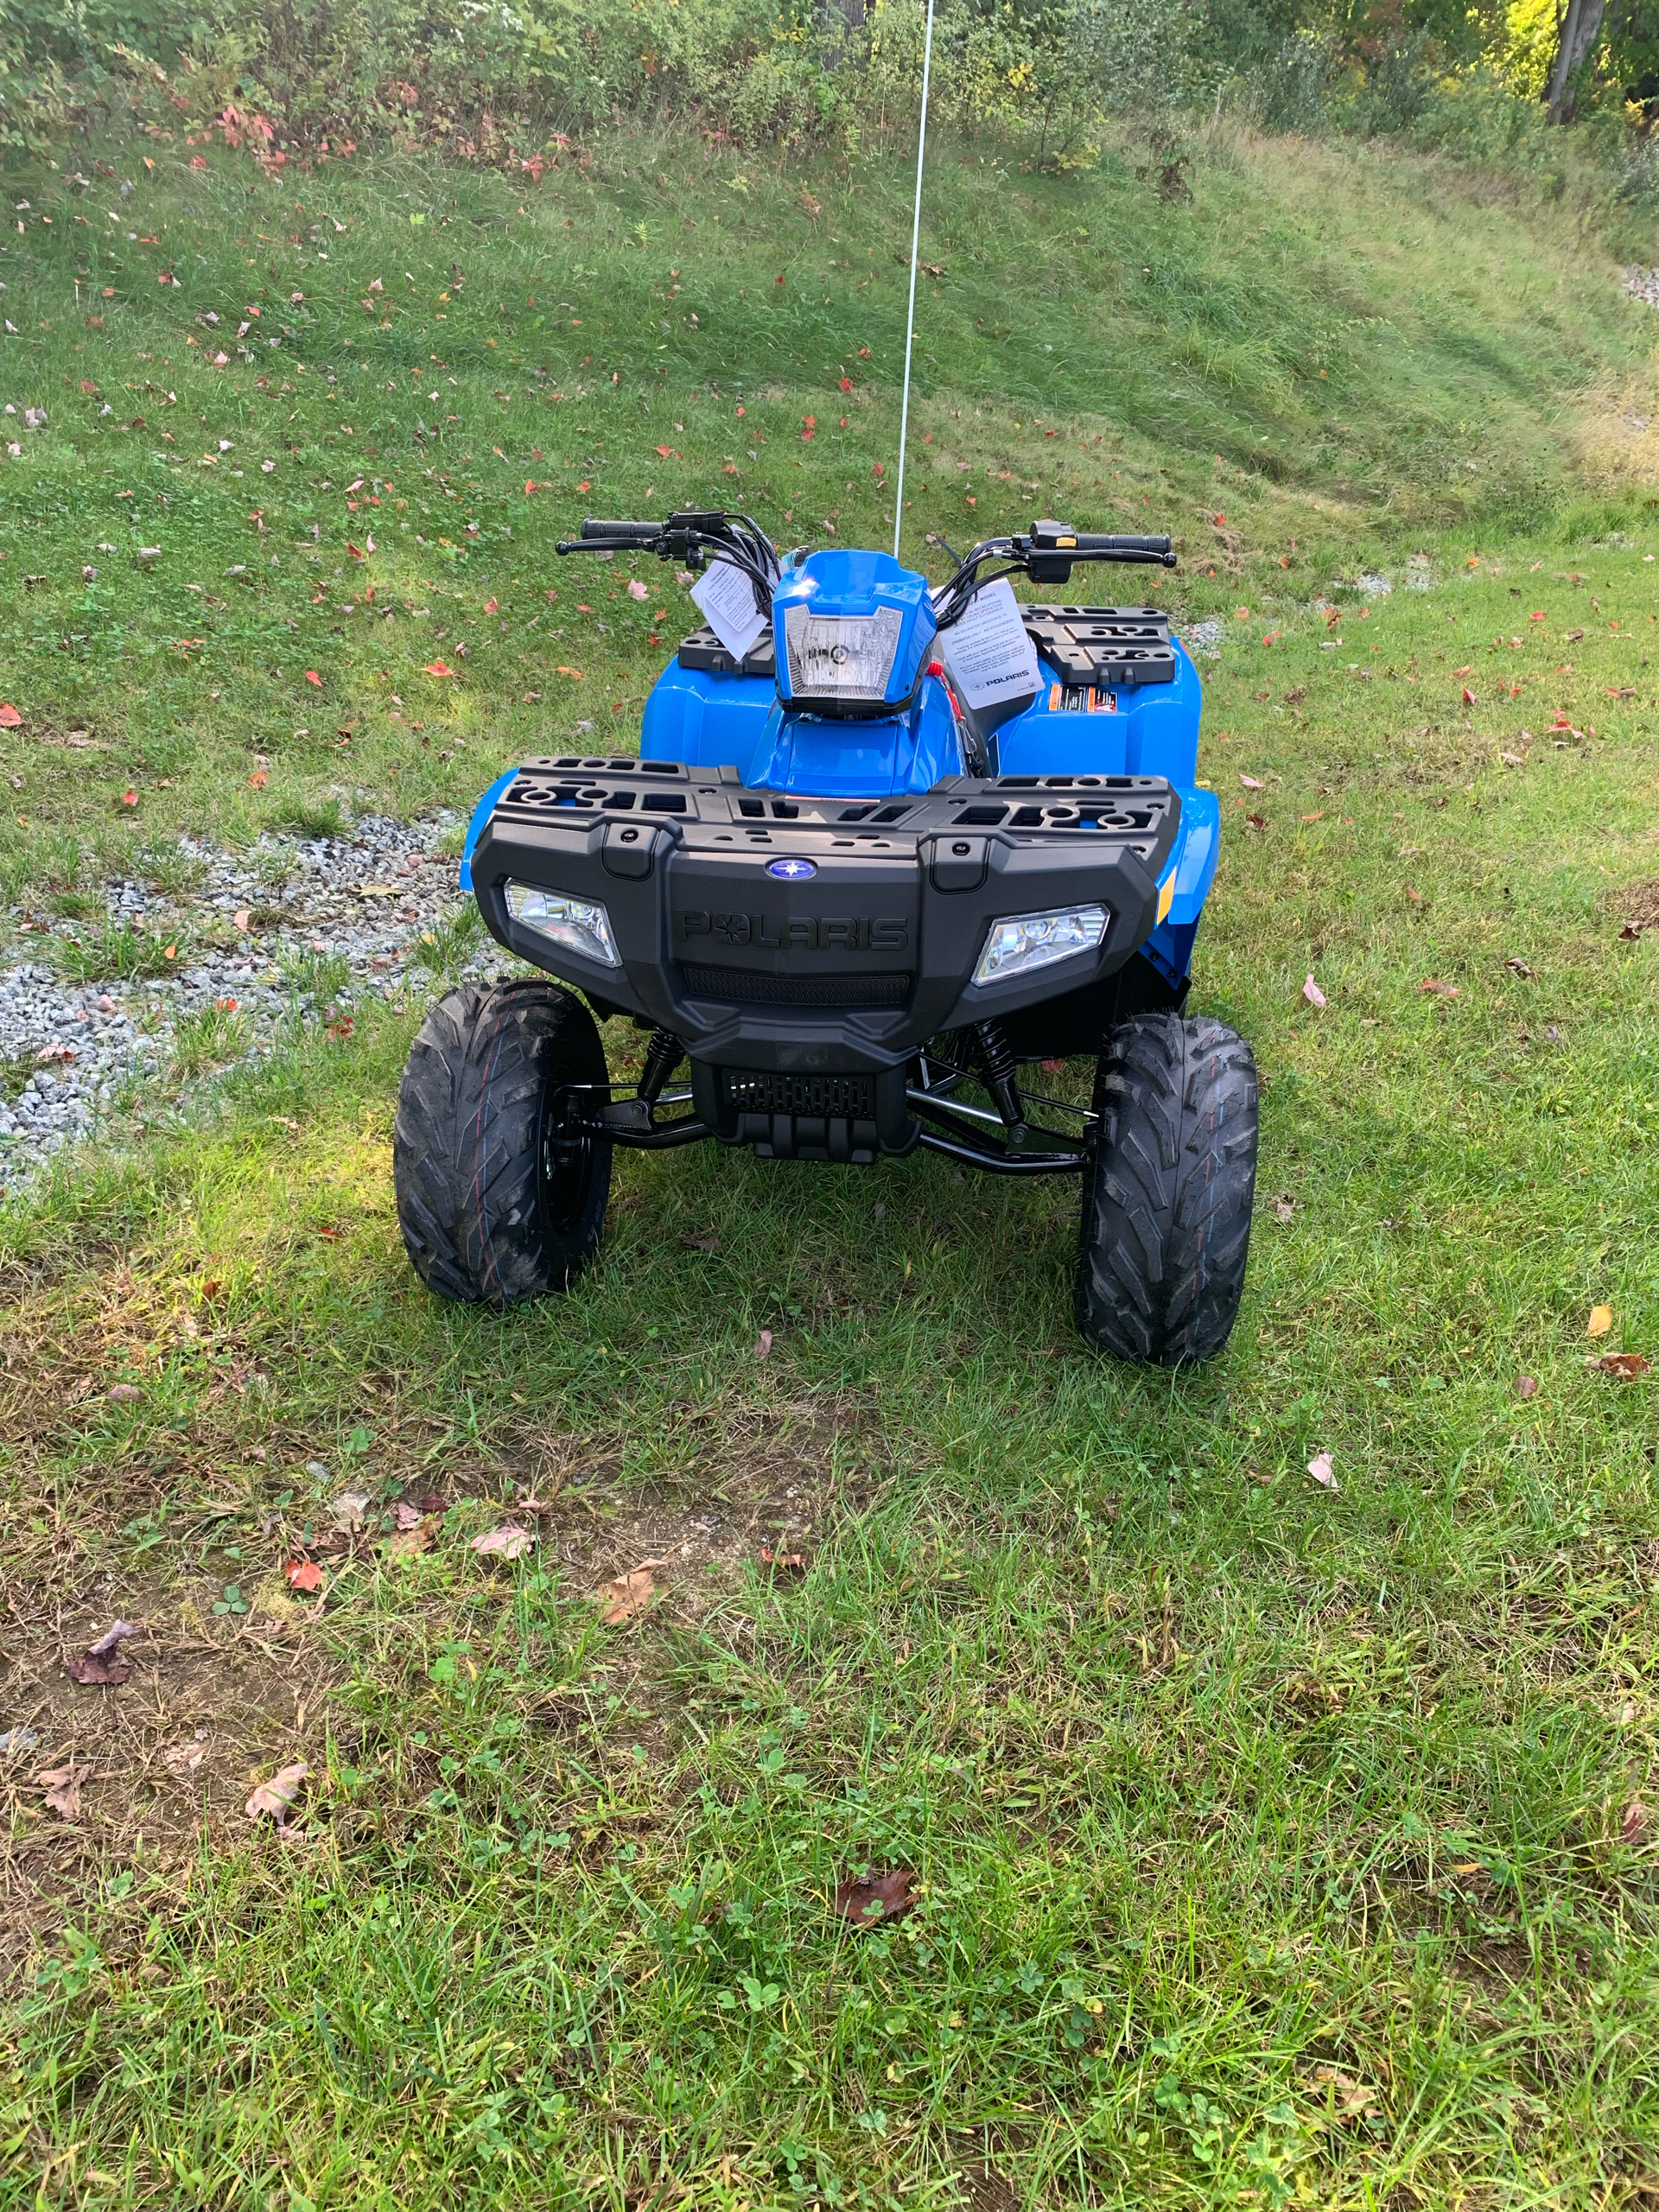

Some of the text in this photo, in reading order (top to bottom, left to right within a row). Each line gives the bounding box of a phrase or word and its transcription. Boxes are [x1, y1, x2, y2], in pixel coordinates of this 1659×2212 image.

[979, 592, 995, 601] MODEL
[974, 599, 1001, 611] RECREATIONAL
[980, 602, 1001, 613] OPERATORS
[979, 606, 1002, 618] SUPERVISION
[951, 634, 971, 645] OPERATOR
[989, 618, 1014, 629] PASSENGERS
[960, 623, 980, 633] OPERATOR
[986, 670, 1029, 686] POLARIS
[676, 908, 908, 950] POLARIS
